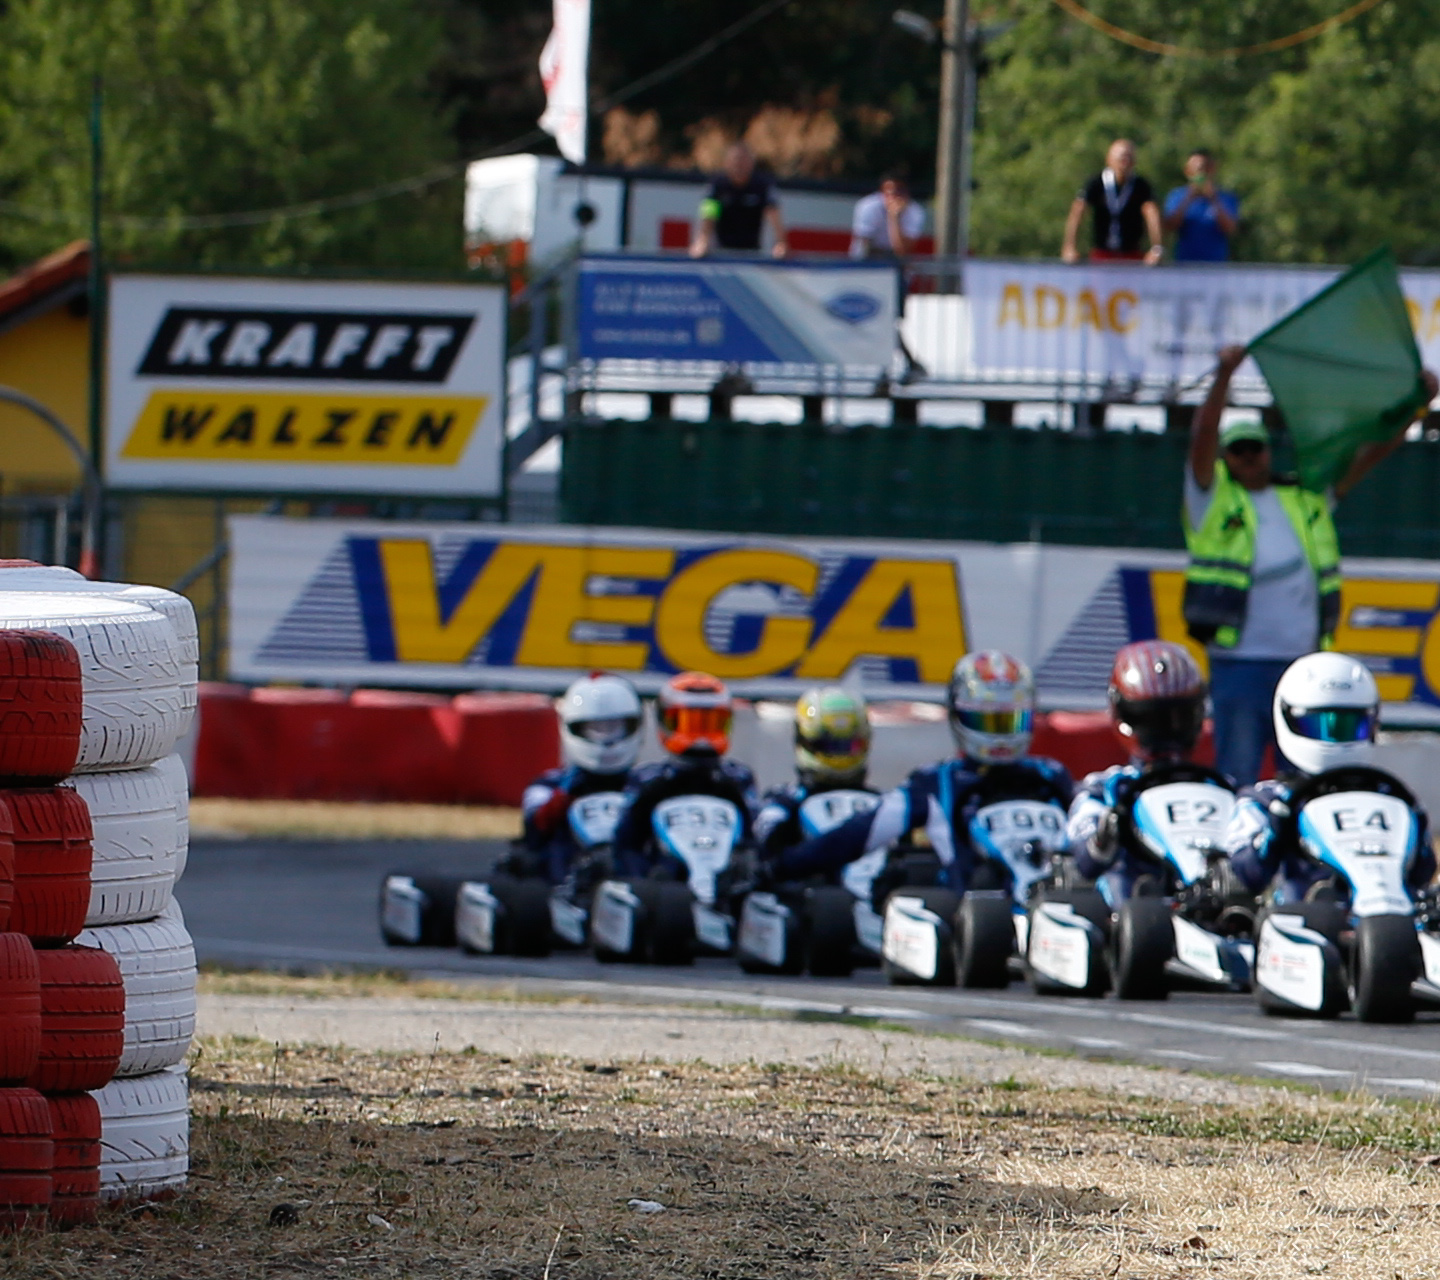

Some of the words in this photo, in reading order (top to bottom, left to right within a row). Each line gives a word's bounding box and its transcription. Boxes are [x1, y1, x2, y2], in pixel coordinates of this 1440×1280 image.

[998, 282, 1137, 335] ADAC
[167, 320, 456, 371] KRAFFT
[160, 405, 456, 450] WALZEN
[372, 537, 968, 684] VEGA
[1166, 800, 1217, 823] E2
[1333, 807, 1390, 831] E4
